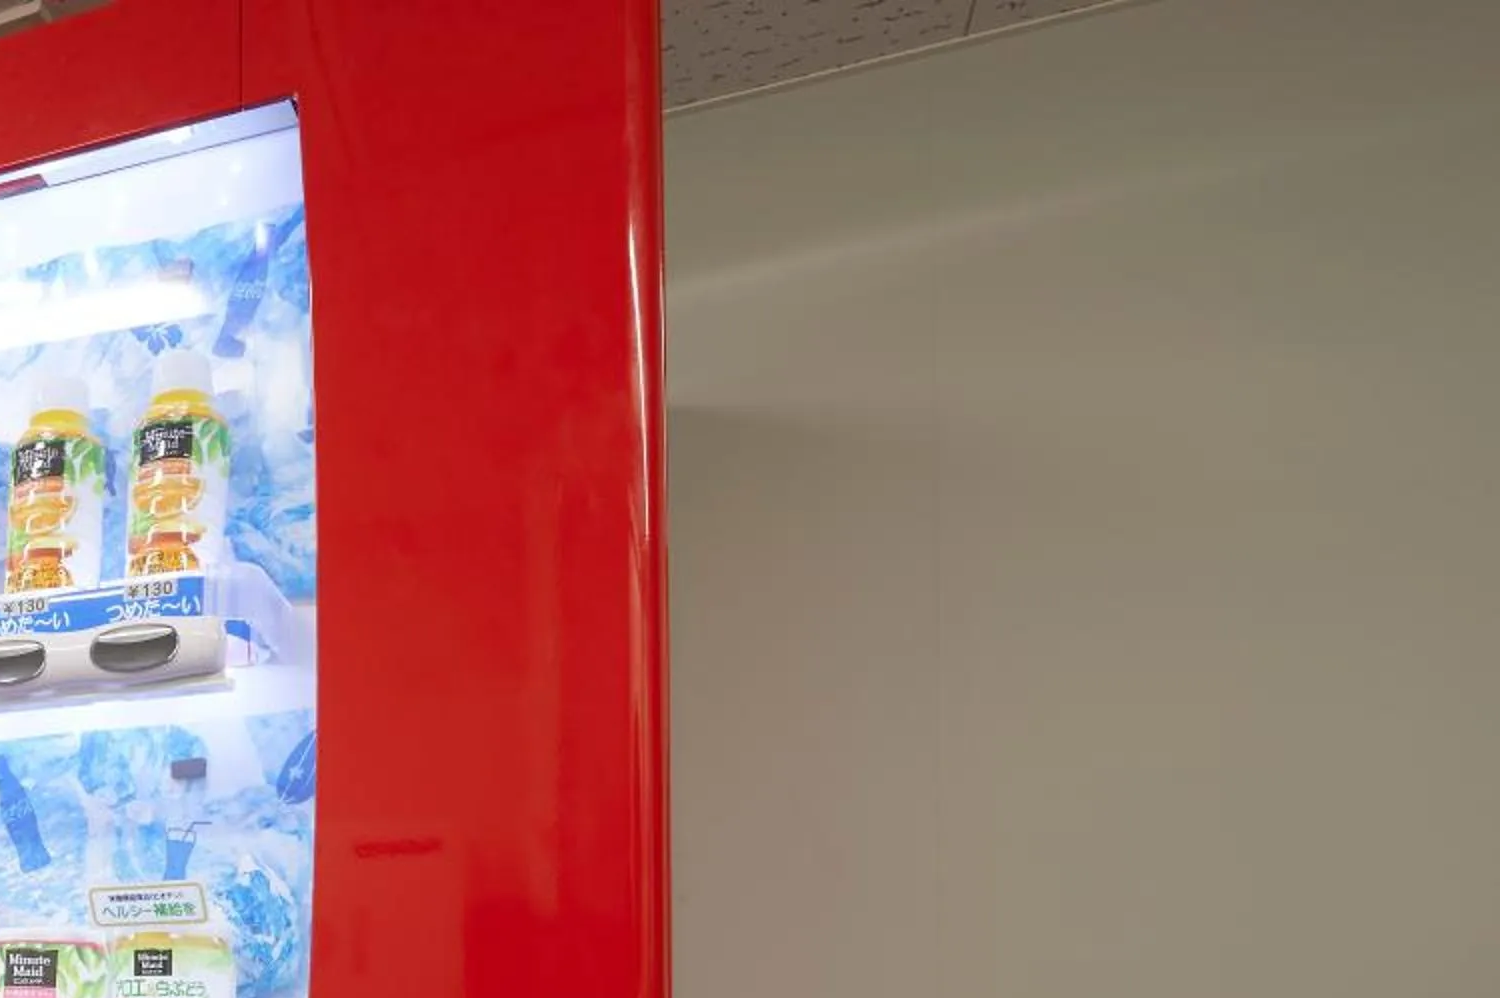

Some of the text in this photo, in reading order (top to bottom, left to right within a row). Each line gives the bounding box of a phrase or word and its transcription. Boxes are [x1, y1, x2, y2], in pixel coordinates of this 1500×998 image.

[128, 581, 173, 597] ¥130
[3, 599, 45, 614] ¥130
[9, 953, 51, 967] Minute
[13, 965, 44, 978] Maid
